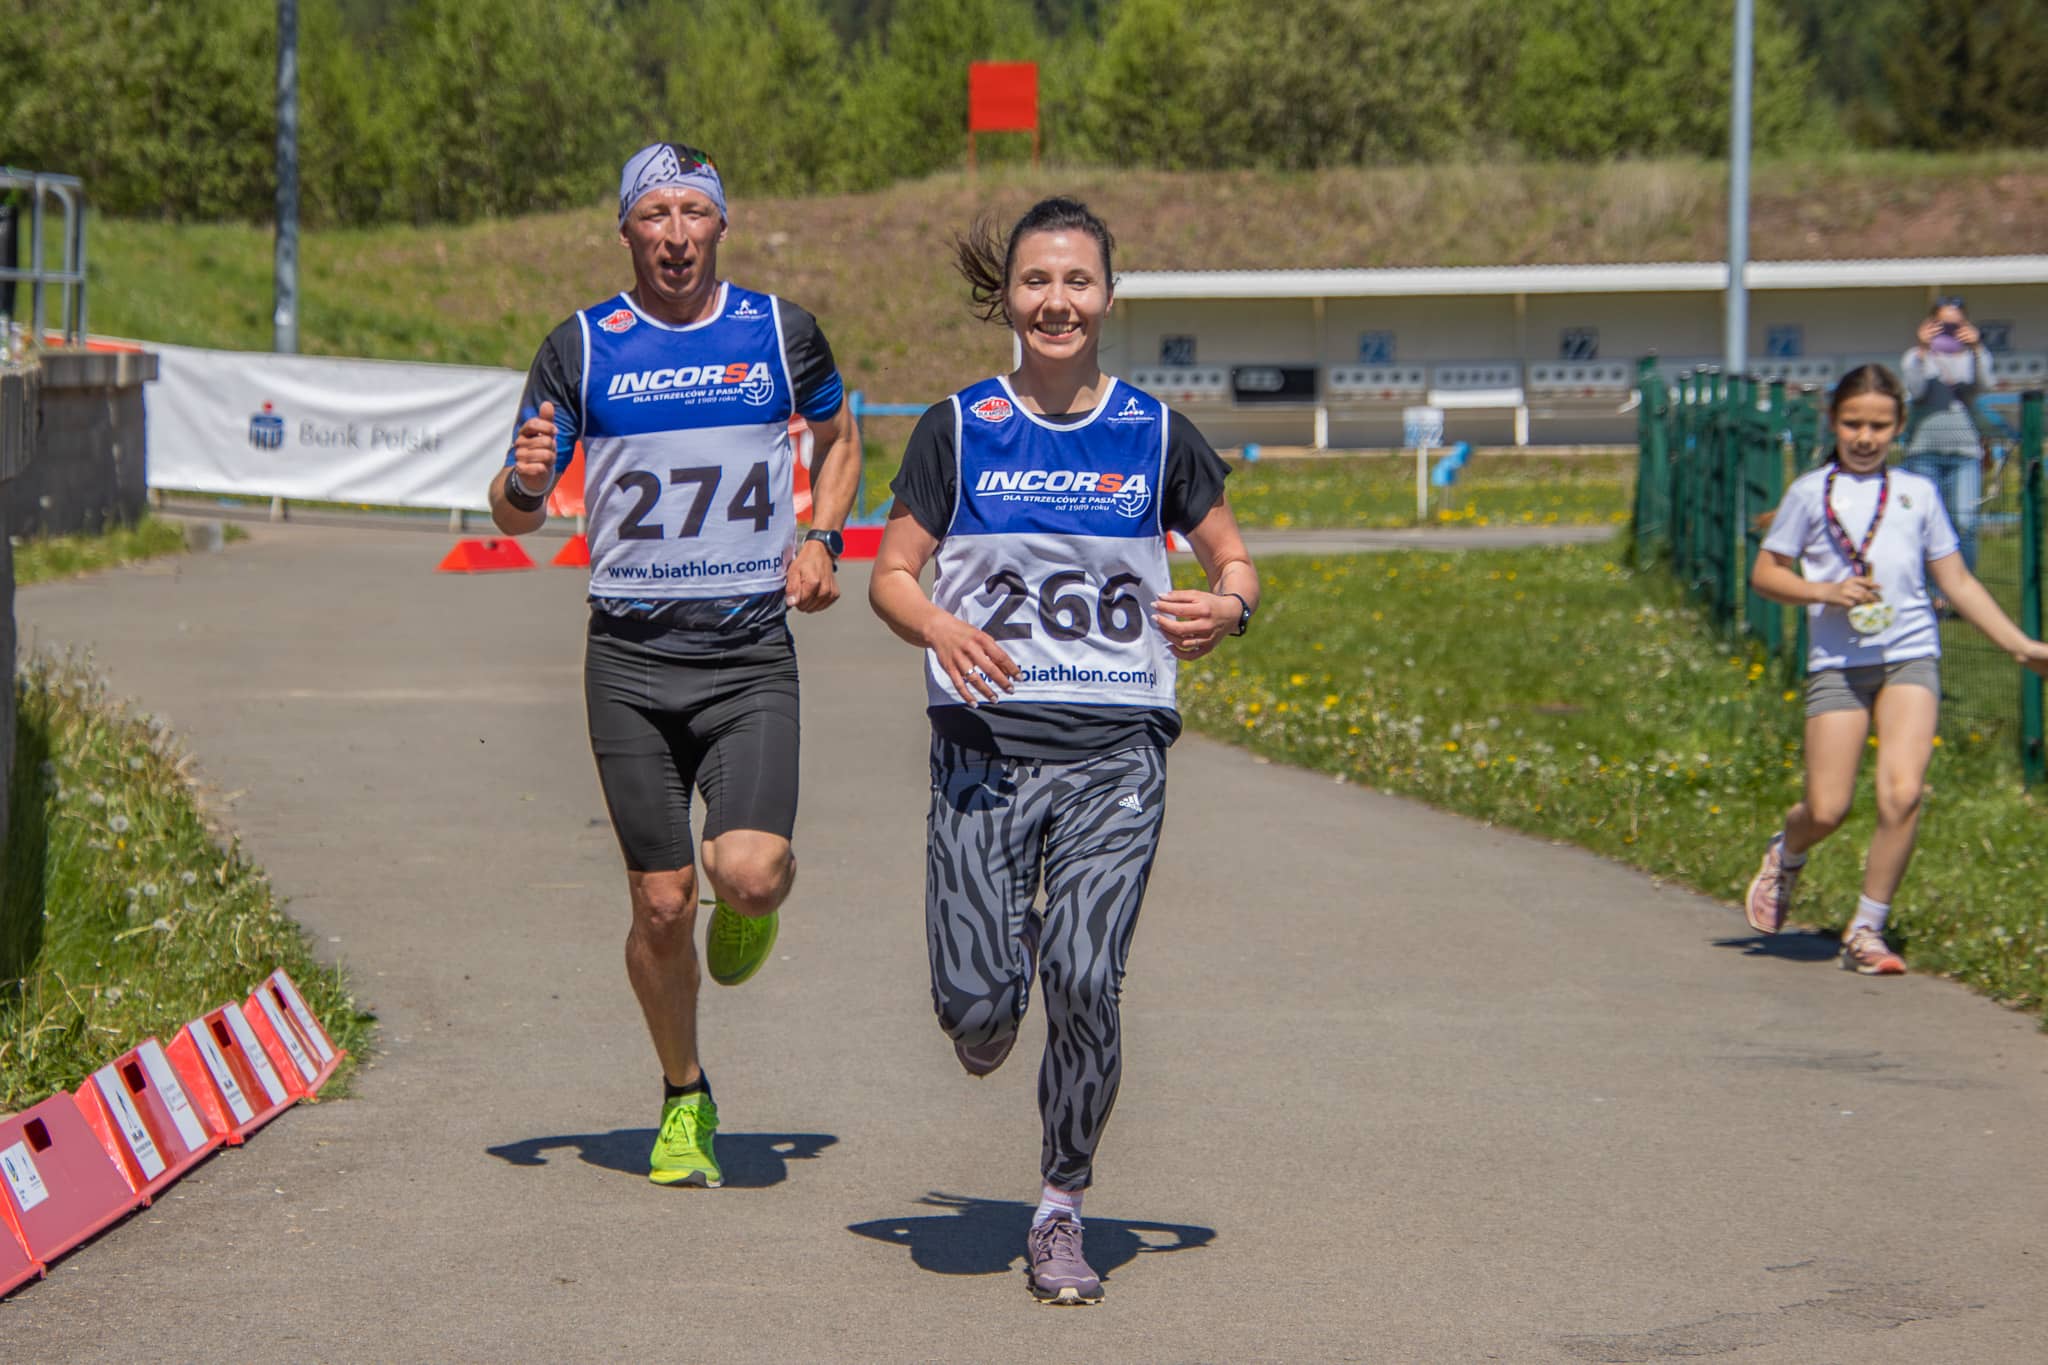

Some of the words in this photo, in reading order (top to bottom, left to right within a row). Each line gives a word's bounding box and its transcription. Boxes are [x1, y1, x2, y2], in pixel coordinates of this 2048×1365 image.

[607, 362, 769, 395] INCORSA
[633, 395, 651, 403] DLA
[299, 421, 359, 449] Bank
[371, 423, 441, 452] Polski
[975, 470, 1146, 493] INCORSA
[613, 461, 775, 540] 274
[1023, 495, 1078, 503] STRZELCÓW
[607, 551, 784, 579] www.biathlon.com.pl
[981, 570, 1143, 642] 266
